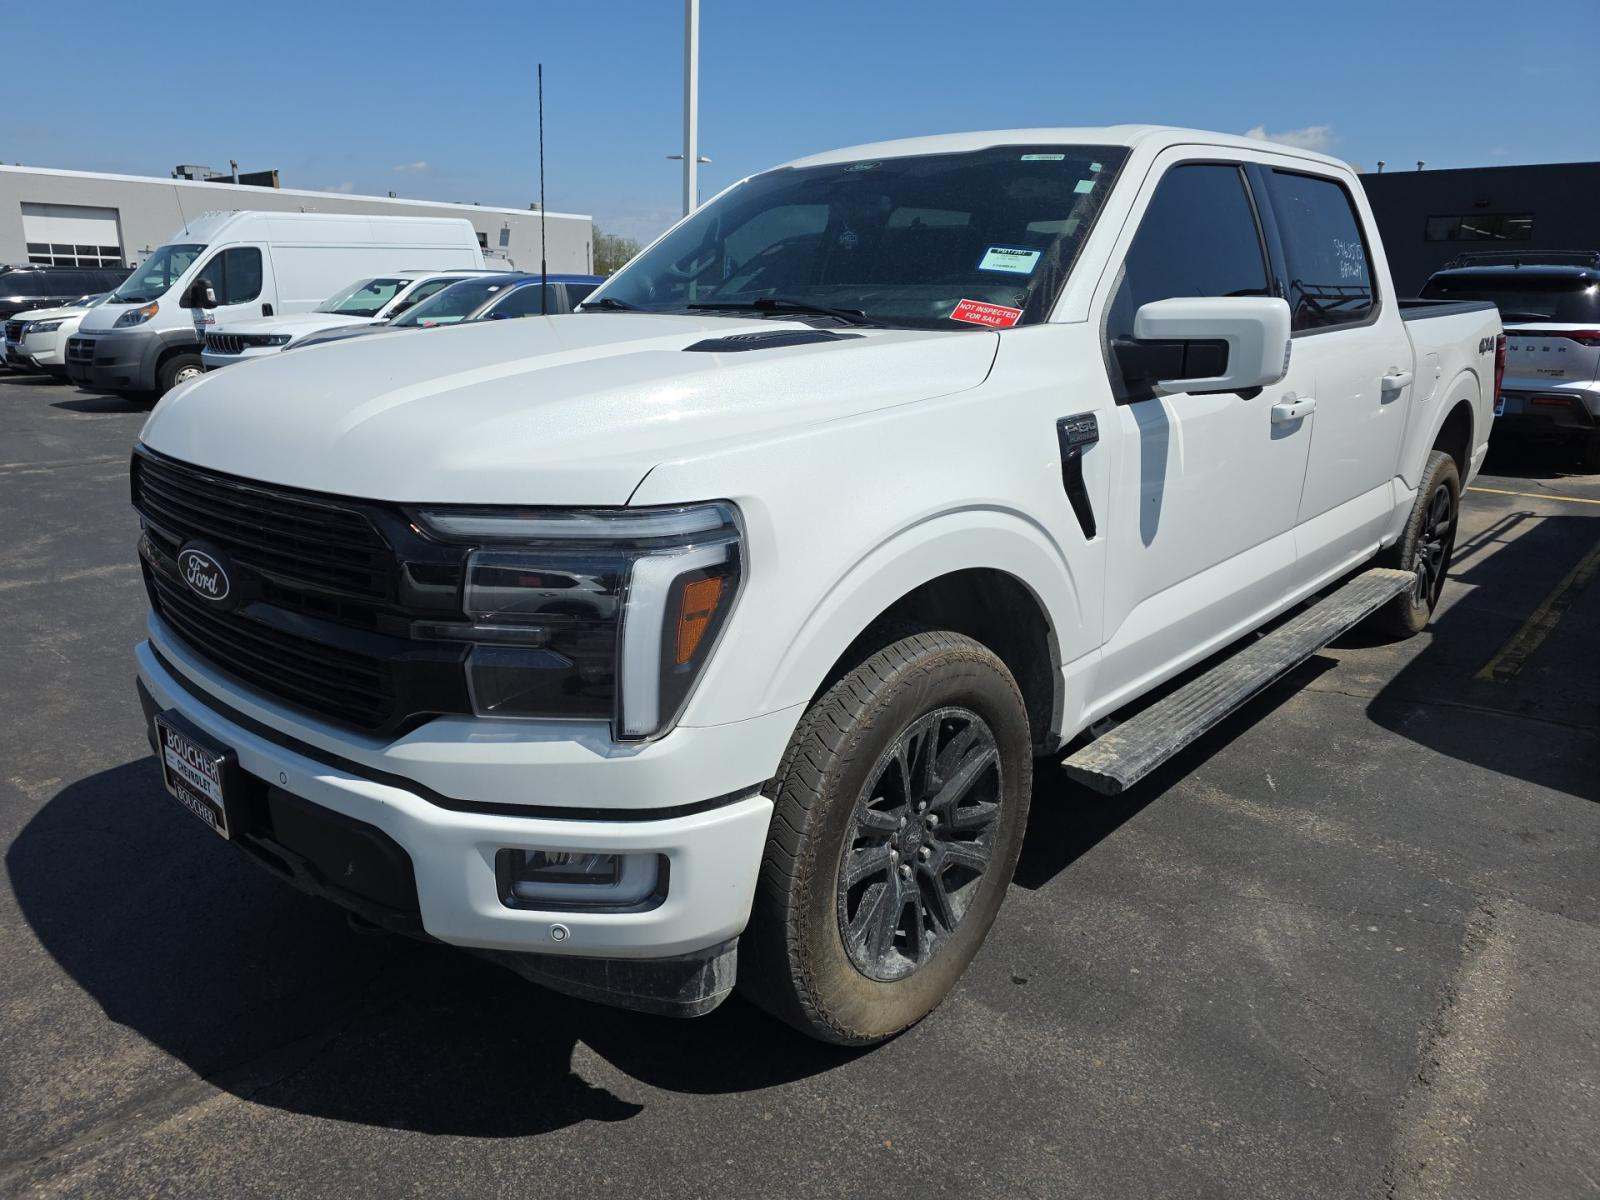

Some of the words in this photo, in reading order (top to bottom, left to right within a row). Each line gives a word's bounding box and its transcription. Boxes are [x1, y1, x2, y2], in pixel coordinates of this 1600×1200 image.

[959, 302, 975, 310] NOT
[975, 305, 1018, 319] INSPECTED
[964, 312, 982, 320] FOR
[981, 314, 1002, 324] SALE
[187, 554, 218, 595] Ford
[166, 727, 219, 783] BOUCHER
[176, 758, 212, 793] CHEVROLET
[176, 785, 215, 825] BOUCHER
